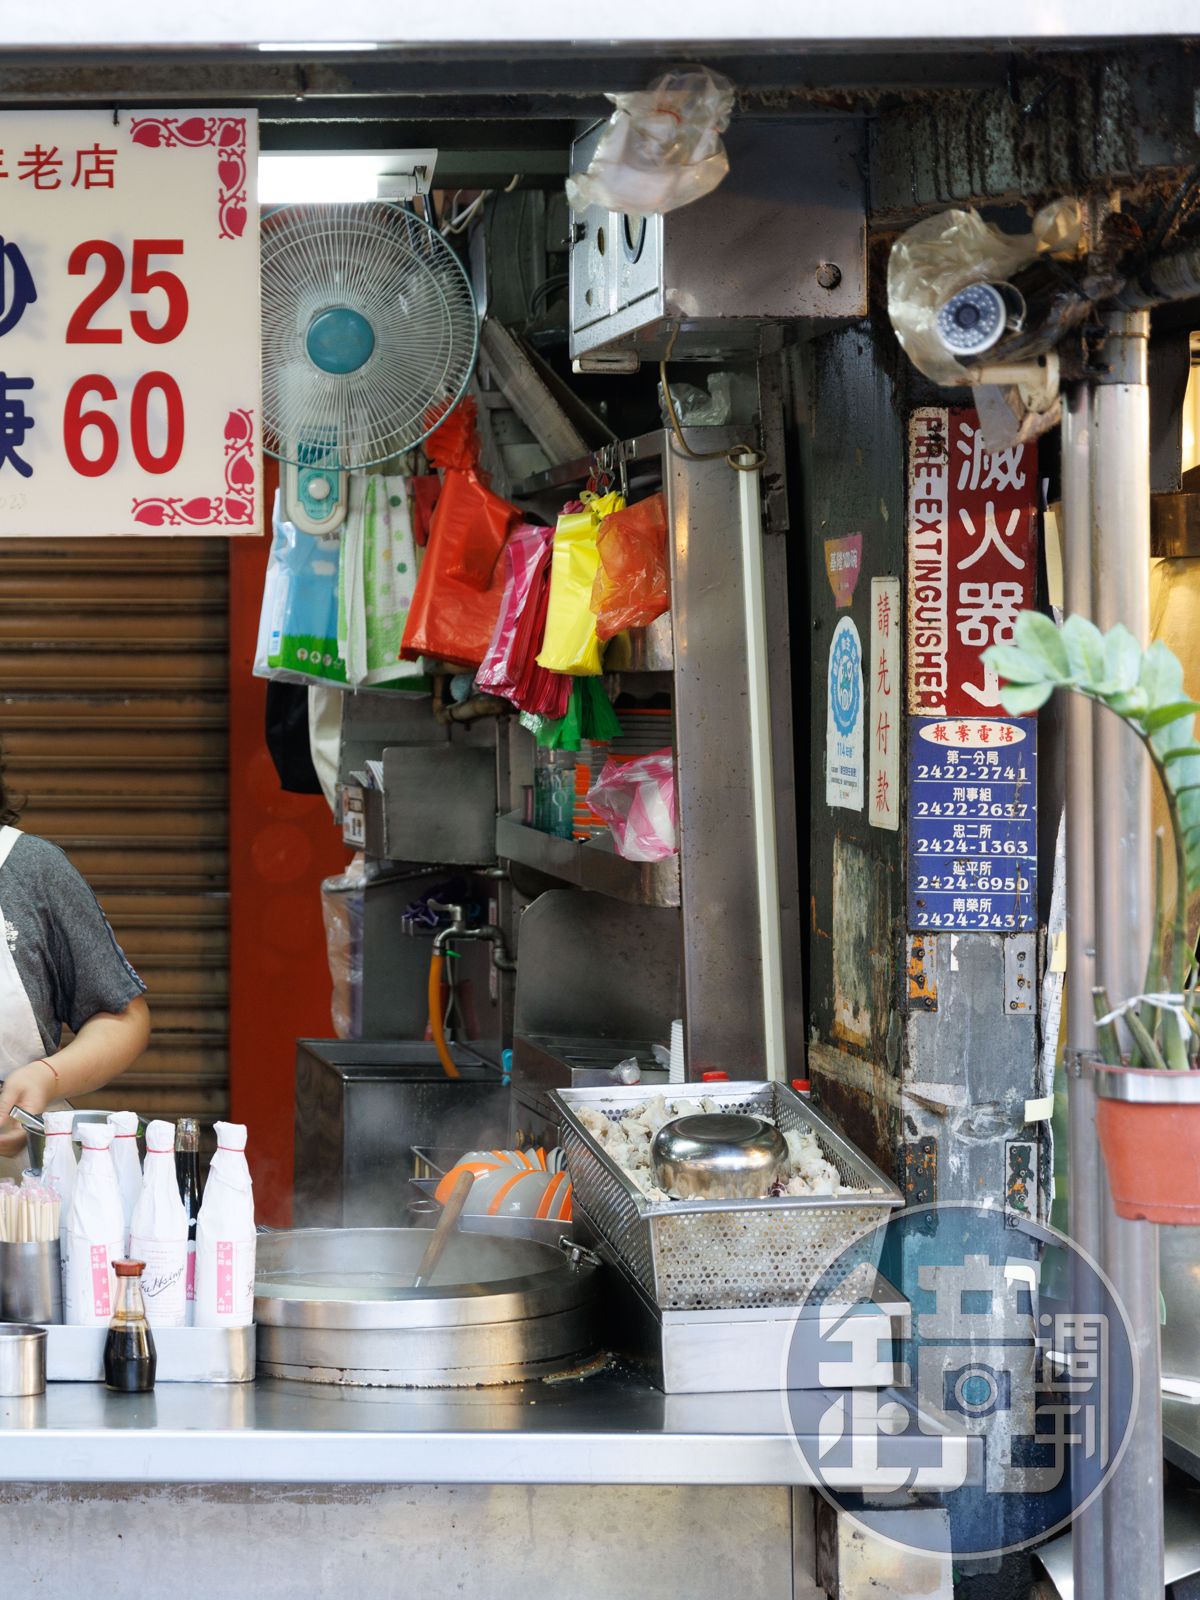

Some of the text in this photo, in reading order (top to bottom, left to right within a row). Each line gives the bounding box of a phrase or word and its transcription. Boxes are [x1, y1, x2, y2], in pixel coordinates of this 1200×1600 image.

[65, 239, 189, 345] 25
[63, 370, 185, 478] 60
[956, 422, 1026, 647] 滅火器
[914, 416, 943, 709] FIRE-EXTINGUISHER
[876, 592, 892, 812] 請先付款
[933, 724, 1014, 743] 報案電話
[947, 750, 999, 766] 第一分局
[917, 765, 1028, 780] 2422-2741
[953, 787, 992, 802] 刑事組
[917, 801, 1028, 817] 2422-2637
[953, 824, 992, 839] 忠二所
[917, 839, 1029, 854] 2424-1363
[953, 861, 992, 876] 延平所
[917, 875, 1029, 891] 2424-6950
[953, 898, 992, 913] 南榮所
[917, 912, 1028, 928] 2424-2437
